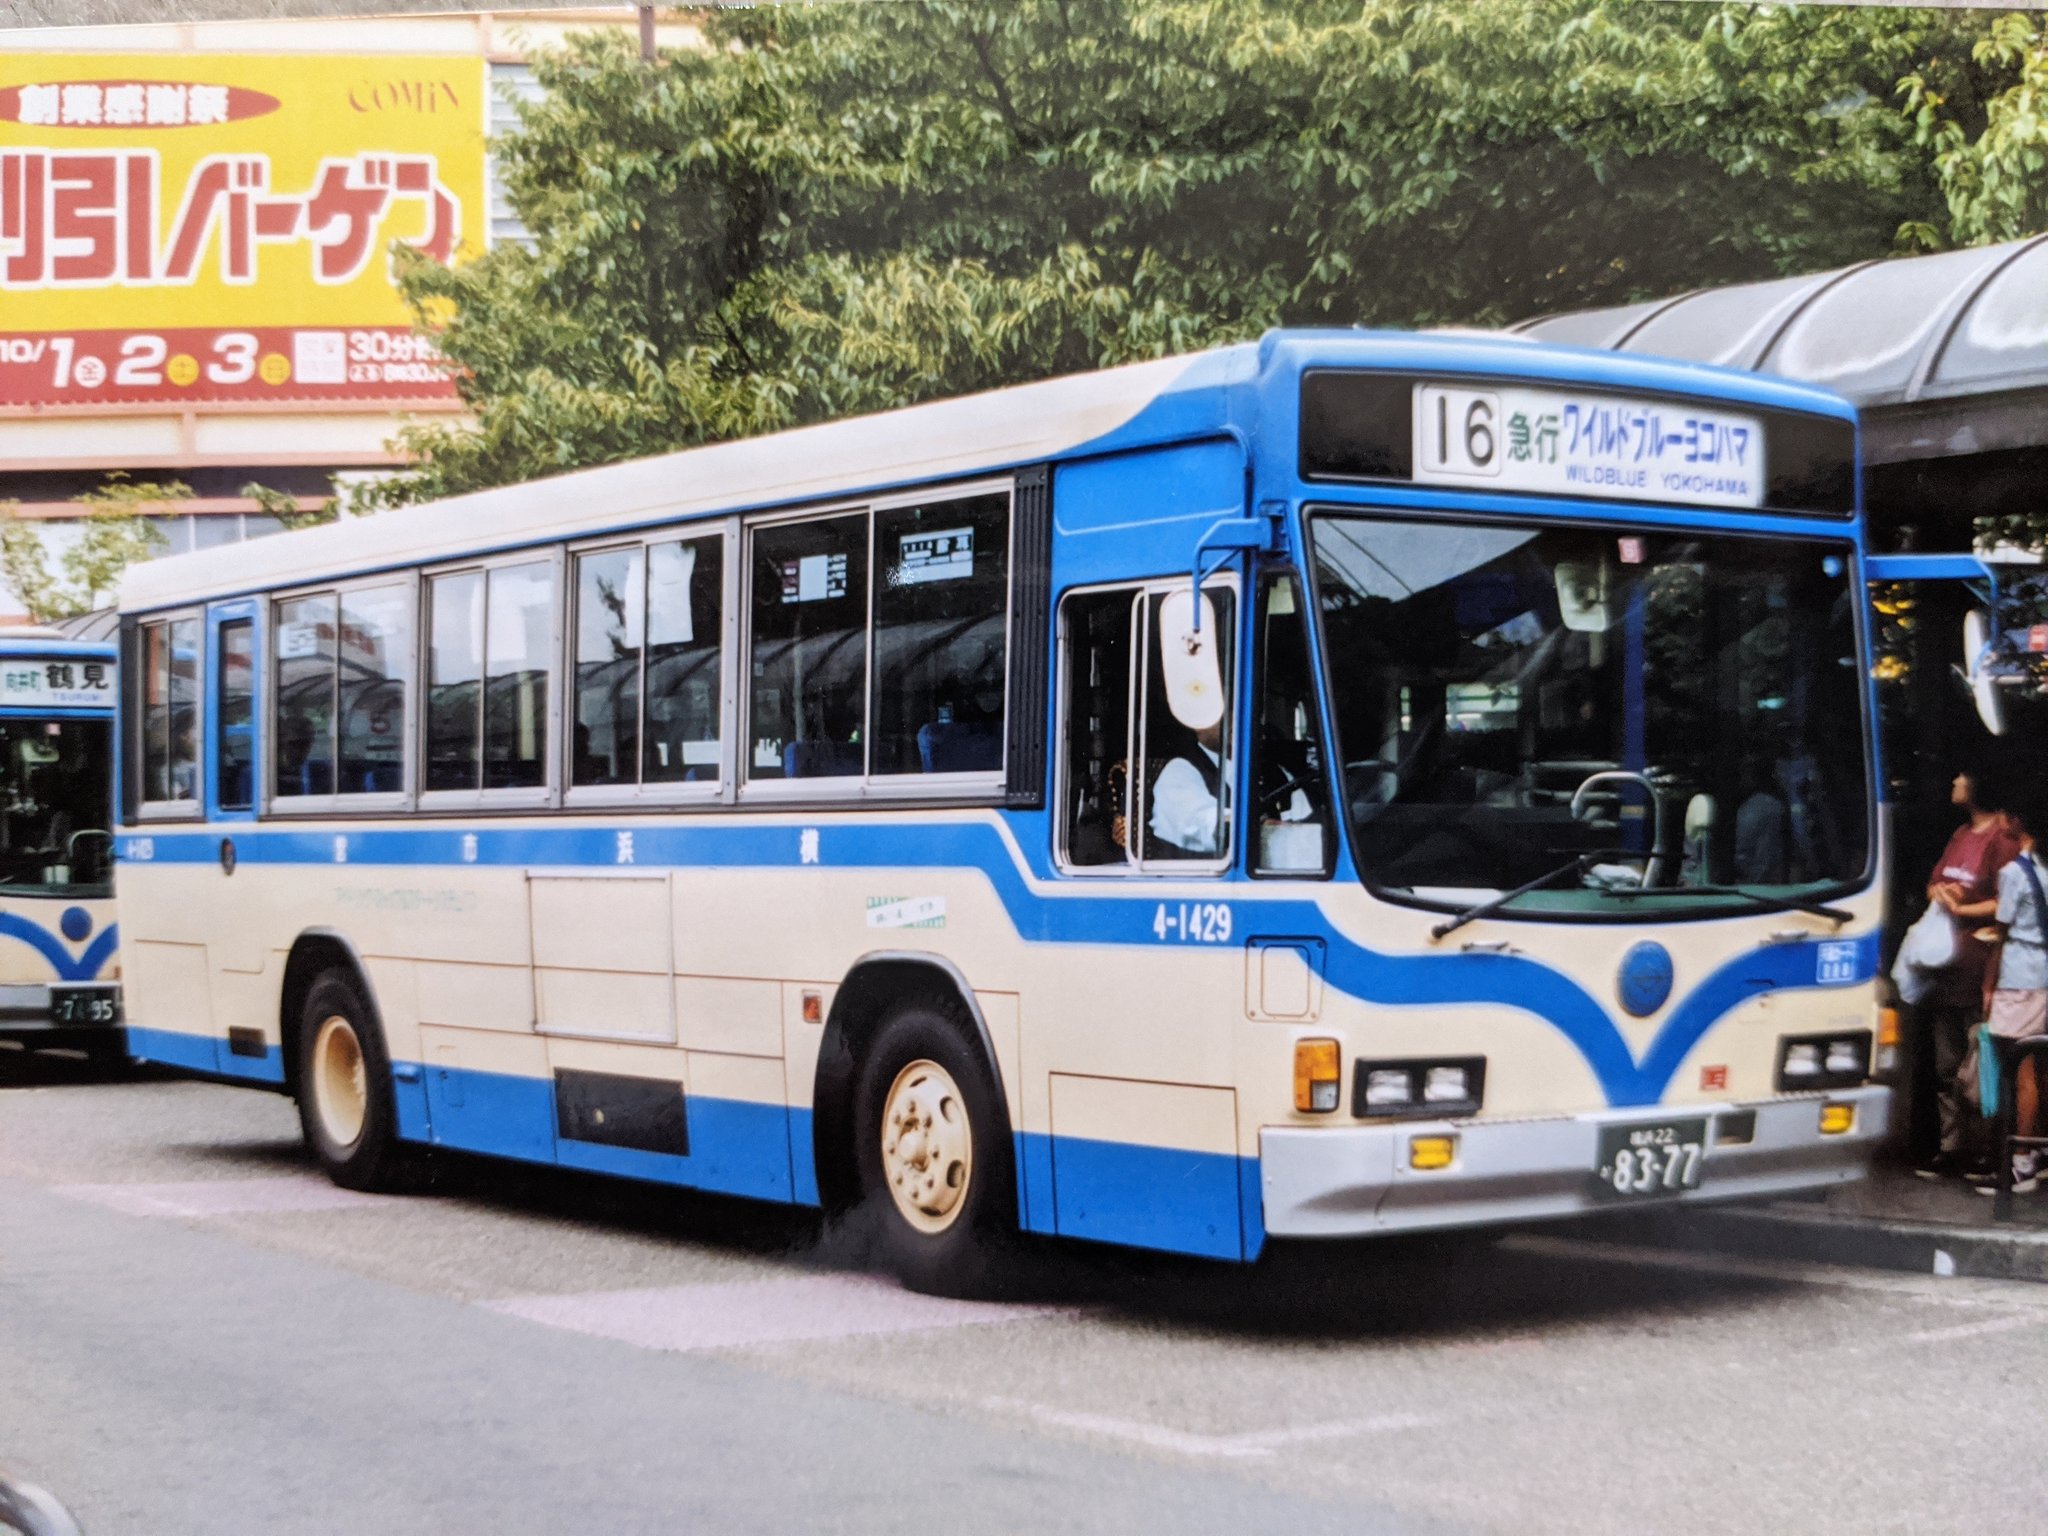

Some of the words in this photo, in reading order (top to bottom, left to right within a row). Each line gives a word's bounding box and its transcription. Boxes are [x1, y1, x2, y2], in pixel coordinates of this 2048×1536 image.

[1437, 395, 1495, 468] 16
[1507, 411, 1560, 464] 急行
[1563, 404, 1748, 467] ワイルドブルーヨコハマ
[1565, 465, 1647, 488] WILDBLUE
[1661, 473, 1749, 496] YOKOHAMA
[1153, 903, 1232, 942] 4-1429
